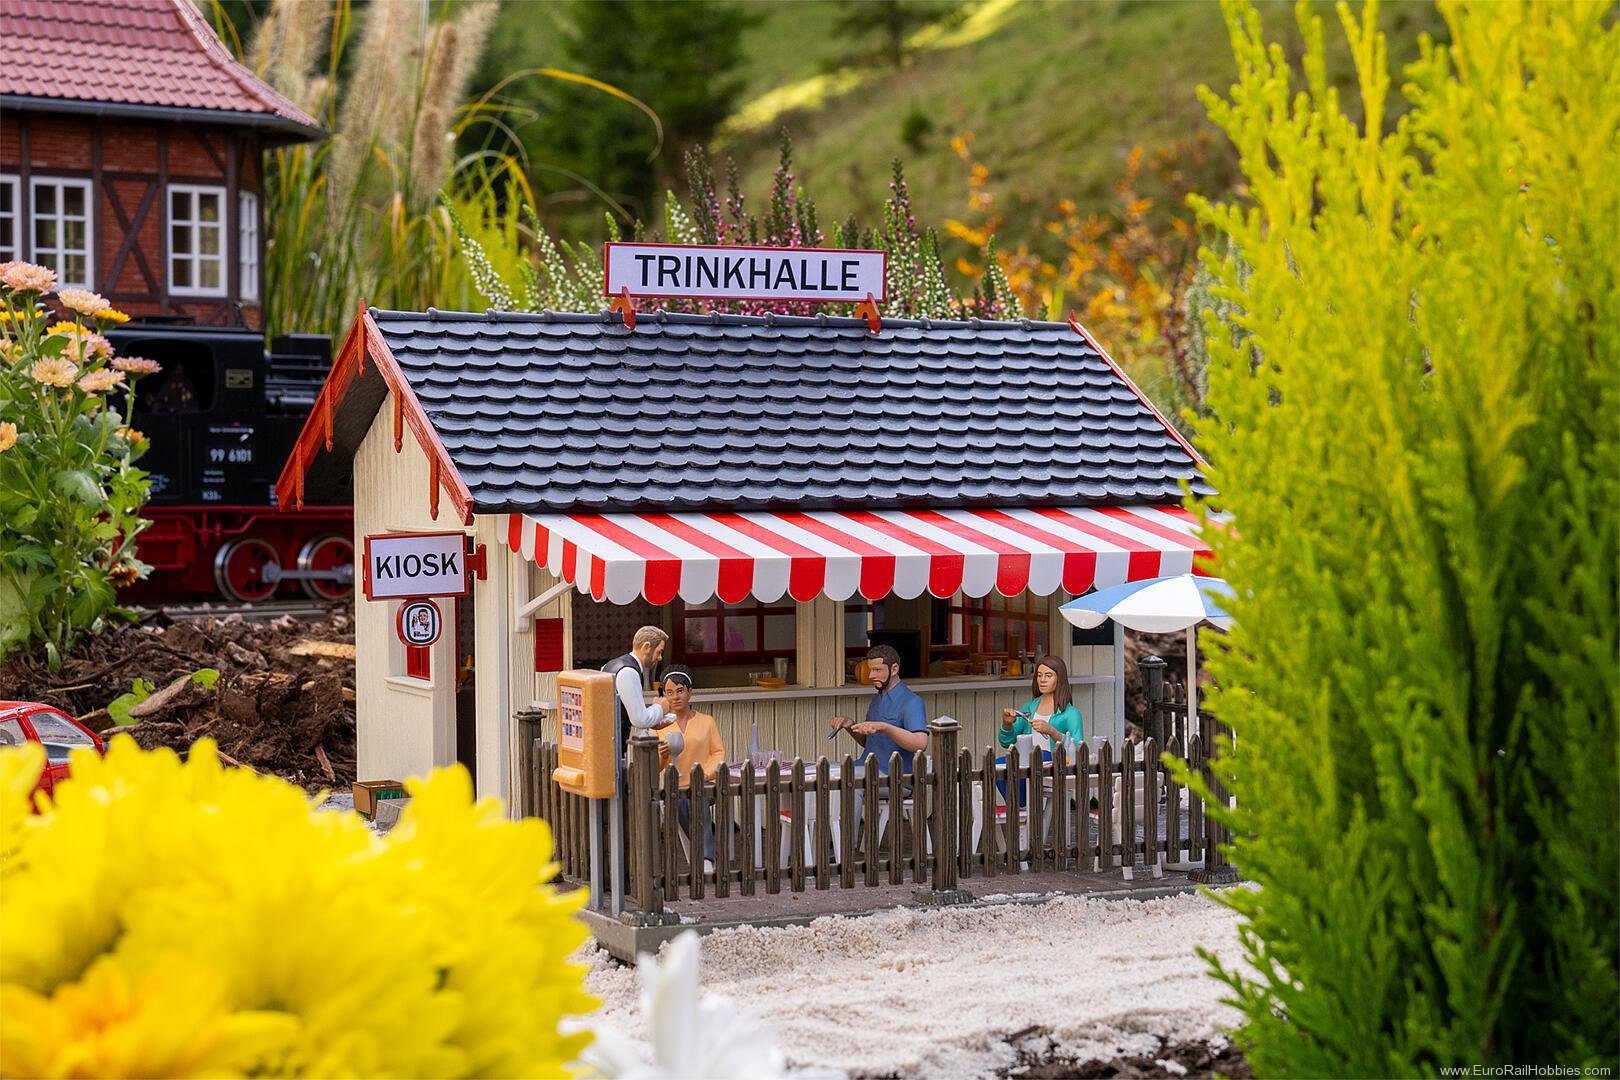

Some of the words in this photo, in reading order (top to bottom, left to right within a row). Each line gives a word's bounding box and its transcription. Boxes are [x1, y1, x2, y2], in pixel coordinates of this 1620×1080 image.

[634, 254, 860, 292] TRINKHALLE
[210, 448, 225, 462] 99
[228, 448, 252, 462] 6101
[375, 552, 459, 579] KIOSK
